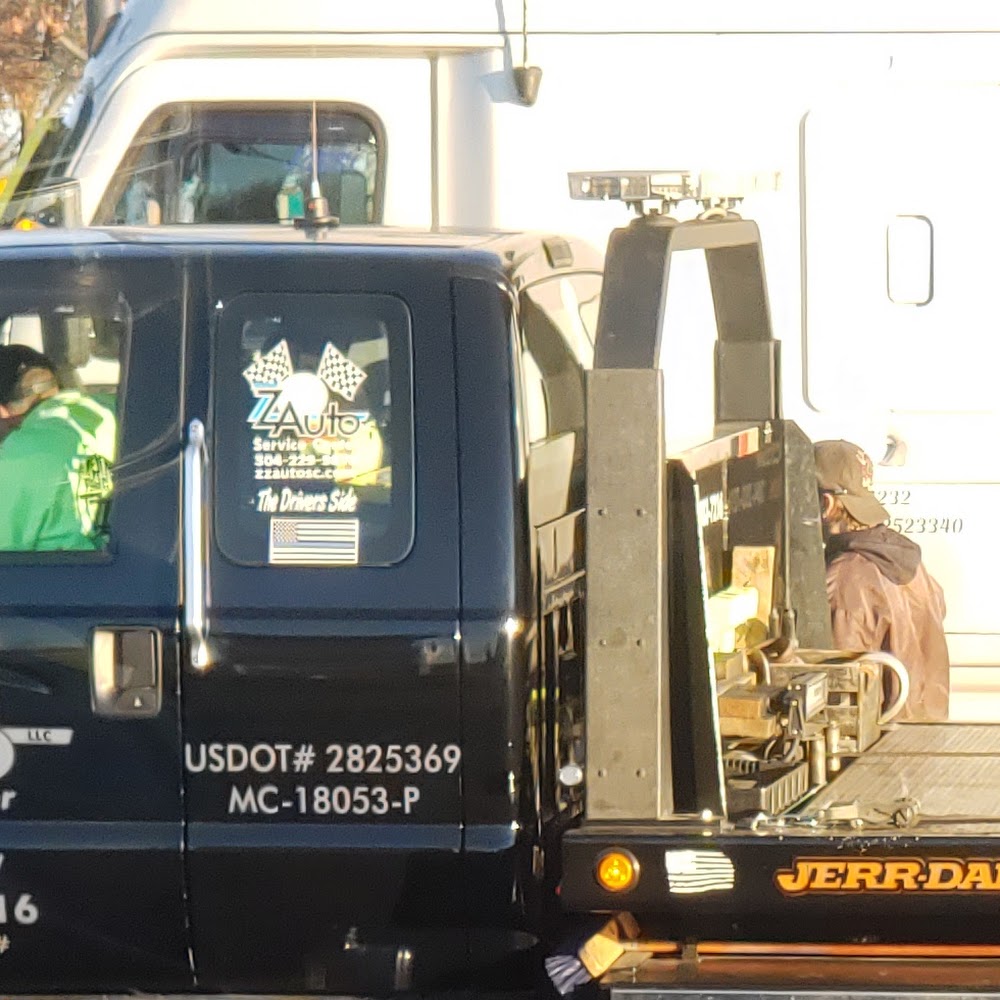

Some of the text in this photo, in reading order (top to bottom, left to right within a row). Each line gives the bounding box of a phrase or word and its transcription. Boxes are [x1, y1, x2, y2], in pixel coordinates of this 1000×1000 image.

[257, 488, 279, 513] The
[328, 487, 358, 513] Side
[27, 730, 52, 741] LLC
[184, 743, 461, 773] USDOT# 2825369
[228, 785, 421, 814] MC-18053-P
